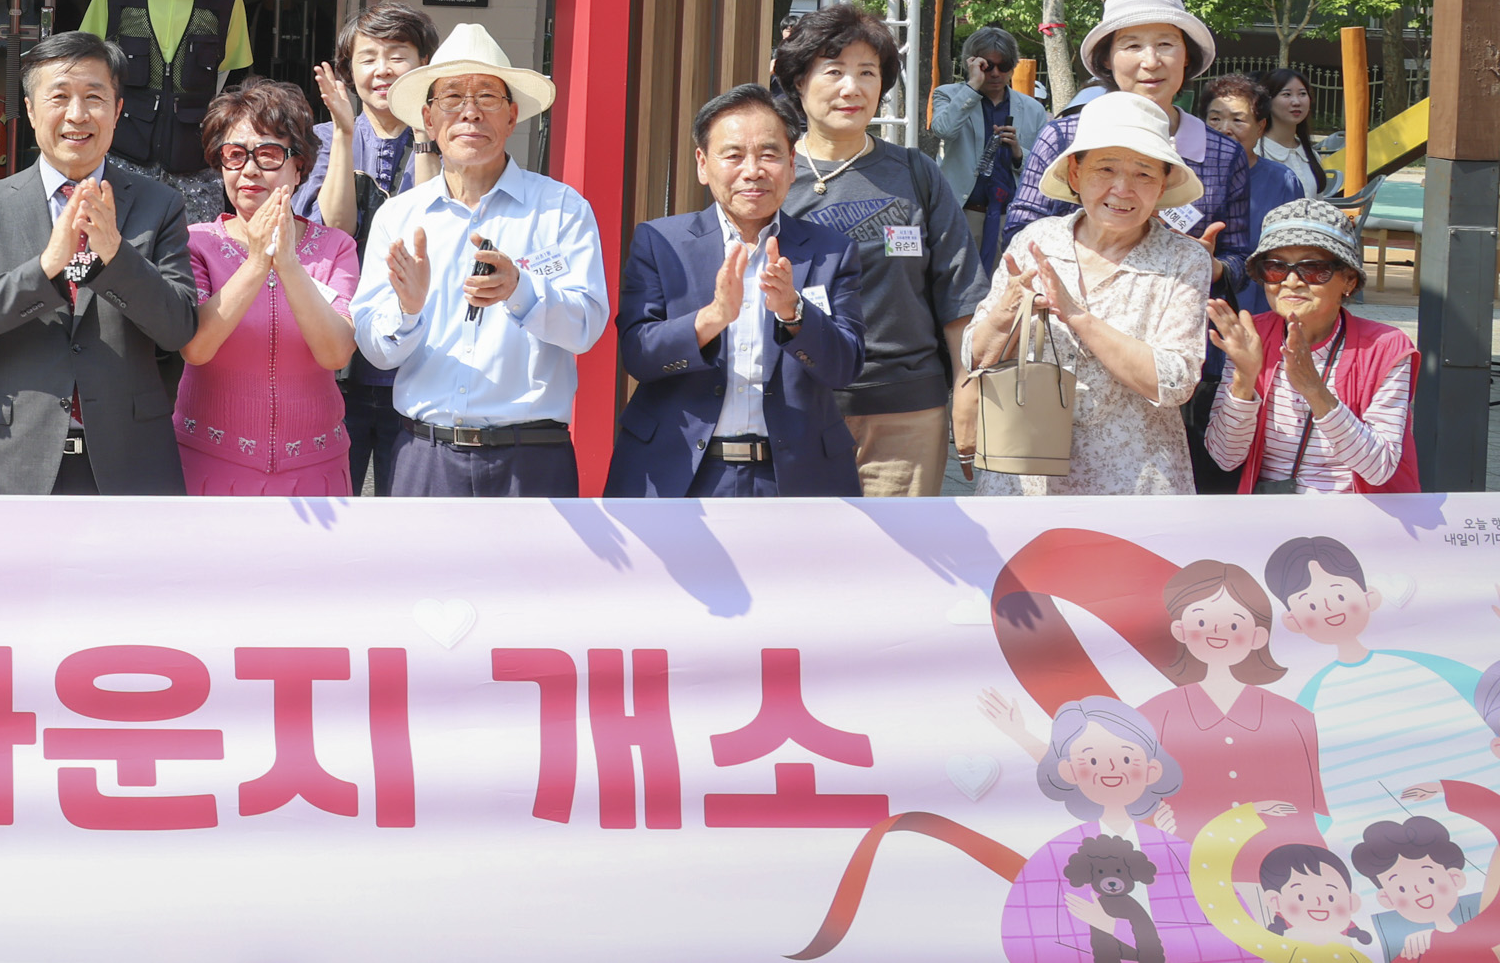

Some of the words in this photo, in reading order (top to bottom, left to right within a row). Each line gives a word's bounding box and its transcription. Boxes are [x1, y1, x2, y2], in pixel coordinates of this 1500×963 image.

[895, 241, 919, 252] 유순희
[1463, 517, 1487, 531] 오늘
[1444, 532, 1479, 546] 내일이
[491, 648, 889, 829] 개소
